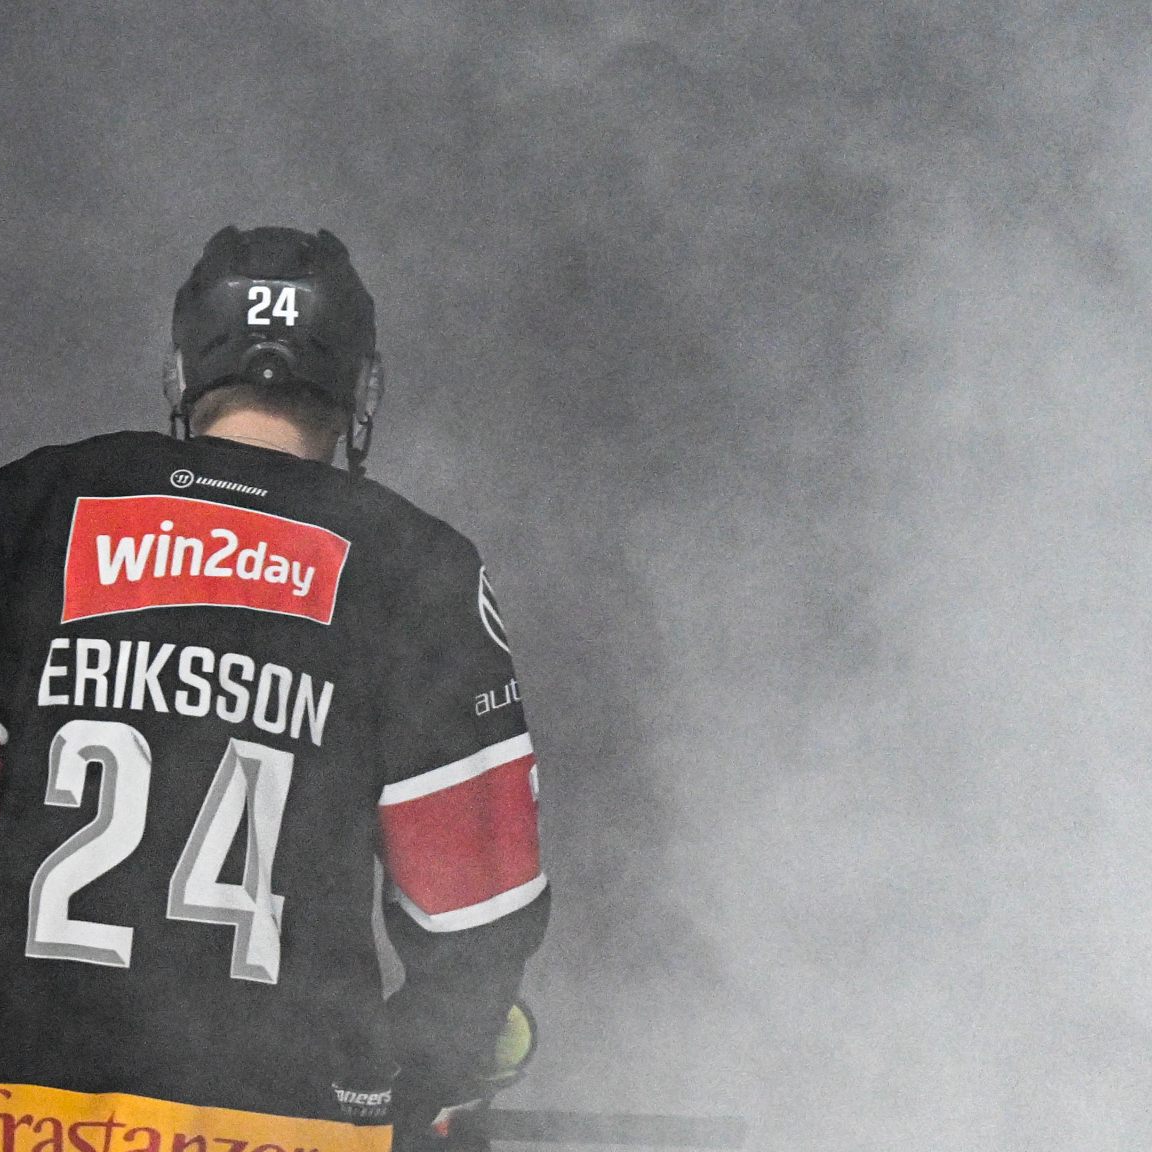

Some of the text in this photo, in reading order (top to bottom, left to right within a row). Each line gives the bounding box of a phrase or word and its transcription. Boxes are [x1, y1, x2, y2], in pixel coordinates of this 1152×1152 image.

[247, 285, 299, 327] 24
[196, 476, 268, 497] WARRIOR
[95, 520, 316, 597] win2day
[38, 637, 335, 747] ERIKSSON
[25, 719, 295, 986] 24
